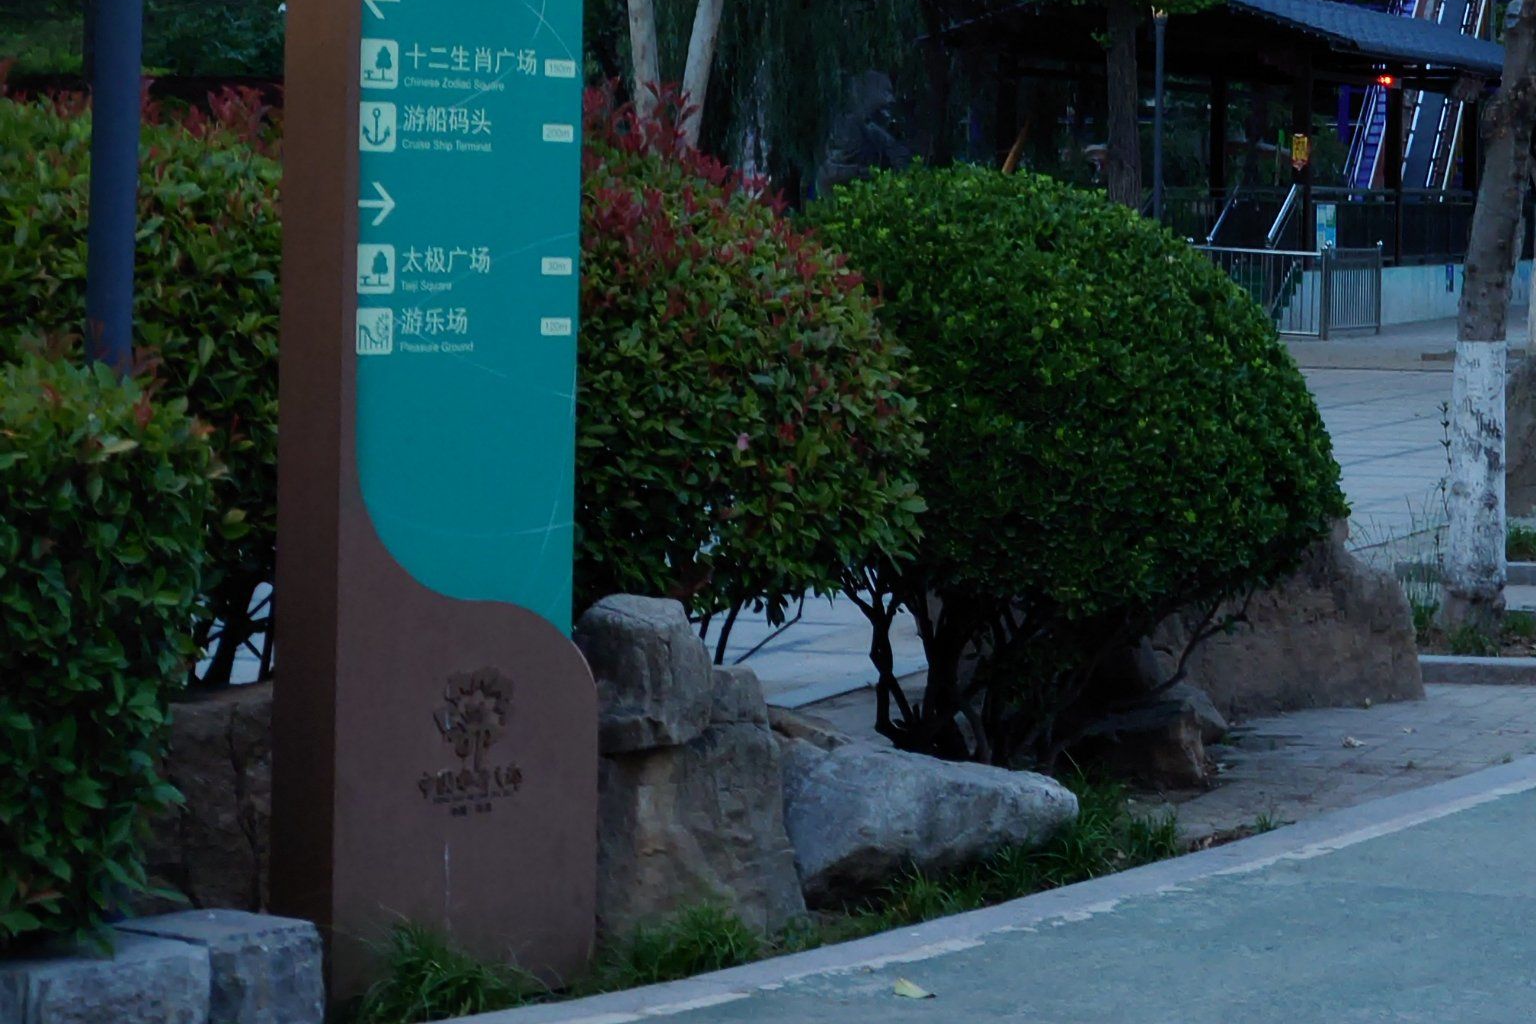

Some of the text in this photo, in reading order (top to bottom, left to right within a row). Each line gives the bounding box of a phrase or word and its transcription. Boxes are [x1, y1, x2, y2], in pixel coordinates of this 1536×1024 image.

[404, 42, 537, 76] 十二生肖广场
[404, 77, 505, 92] Chinese Zodiac Square
[402, 104, 492, 135] 游船码头
[402, 139, 492, 153] Cruise Ship Terminal
[401, 245, 491, 274] 太极广场
[421, 280, 452, 293] Square
[401, 307, 468, 336] 游乐场
[400, 342, 474, 353] Pleasure Ground
